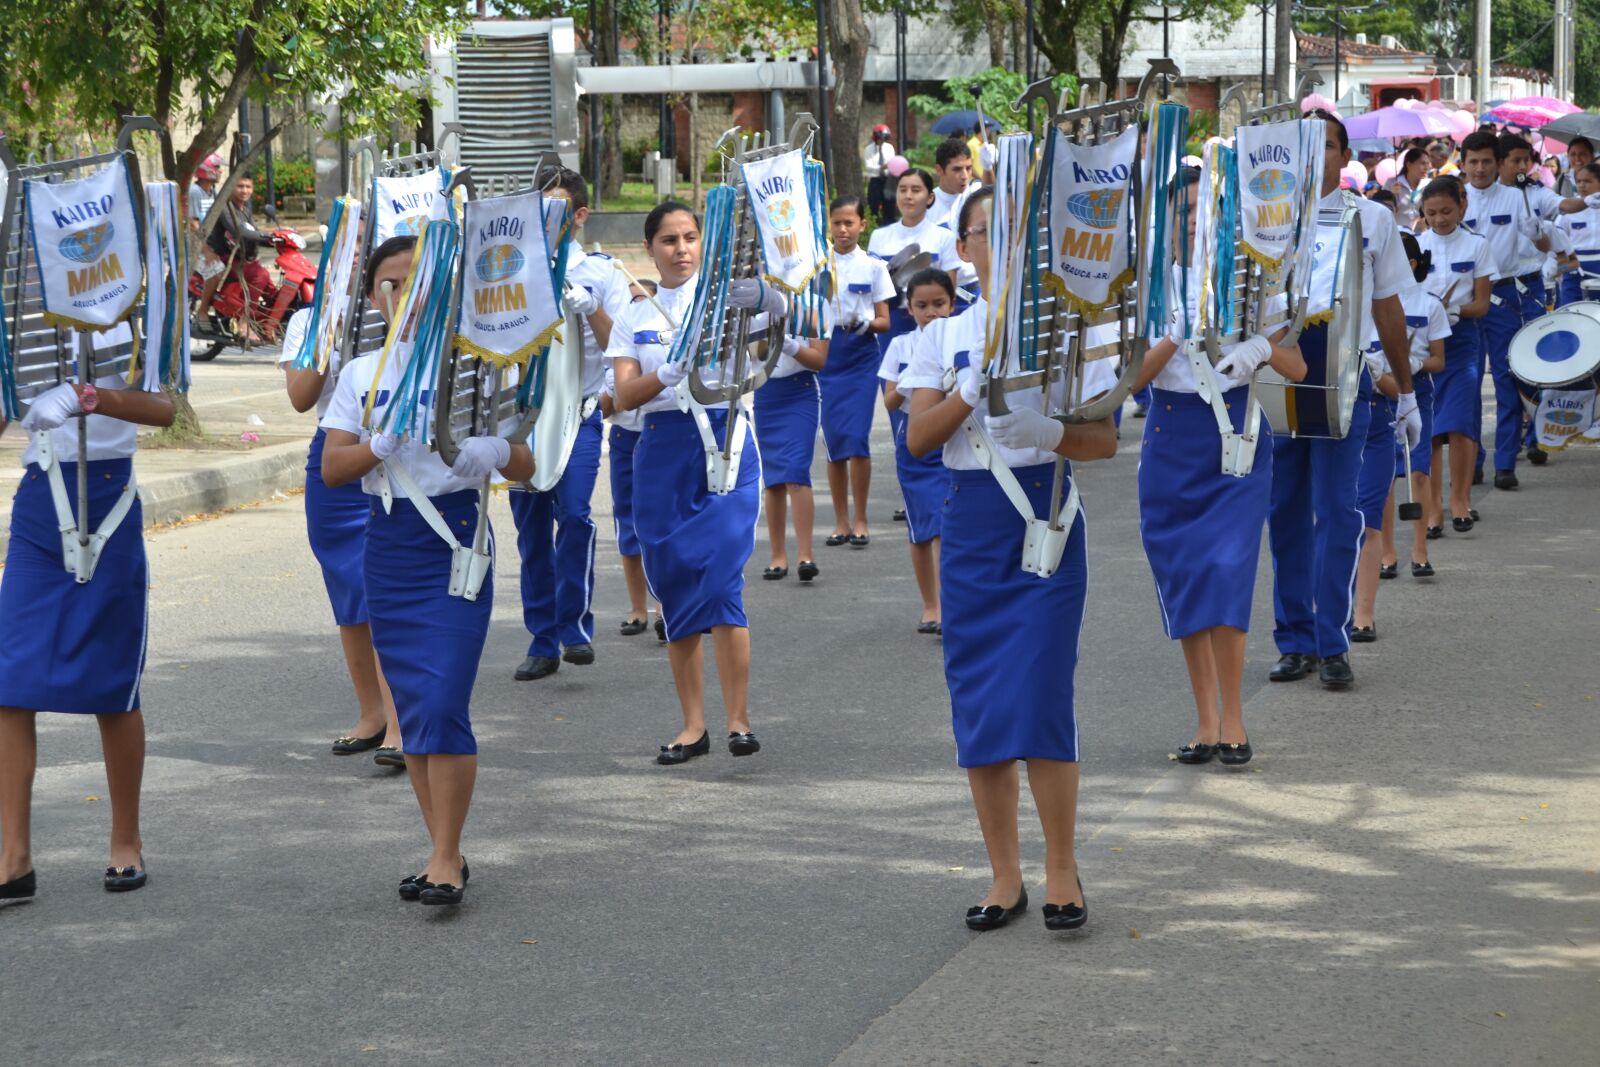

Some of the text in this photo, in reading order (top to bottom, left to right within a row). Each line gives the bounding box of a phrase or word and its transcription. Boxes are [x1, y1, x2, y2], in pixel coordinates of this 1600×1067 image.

[1249, 144, 1291, 169] KAIROS
[480, 216, 526, 246] KAIROS
[66, 253, 124, 297] MMM
[1060, 262, 1091, 279] ARAUCA
[474, 282, 528, 316] MMM
